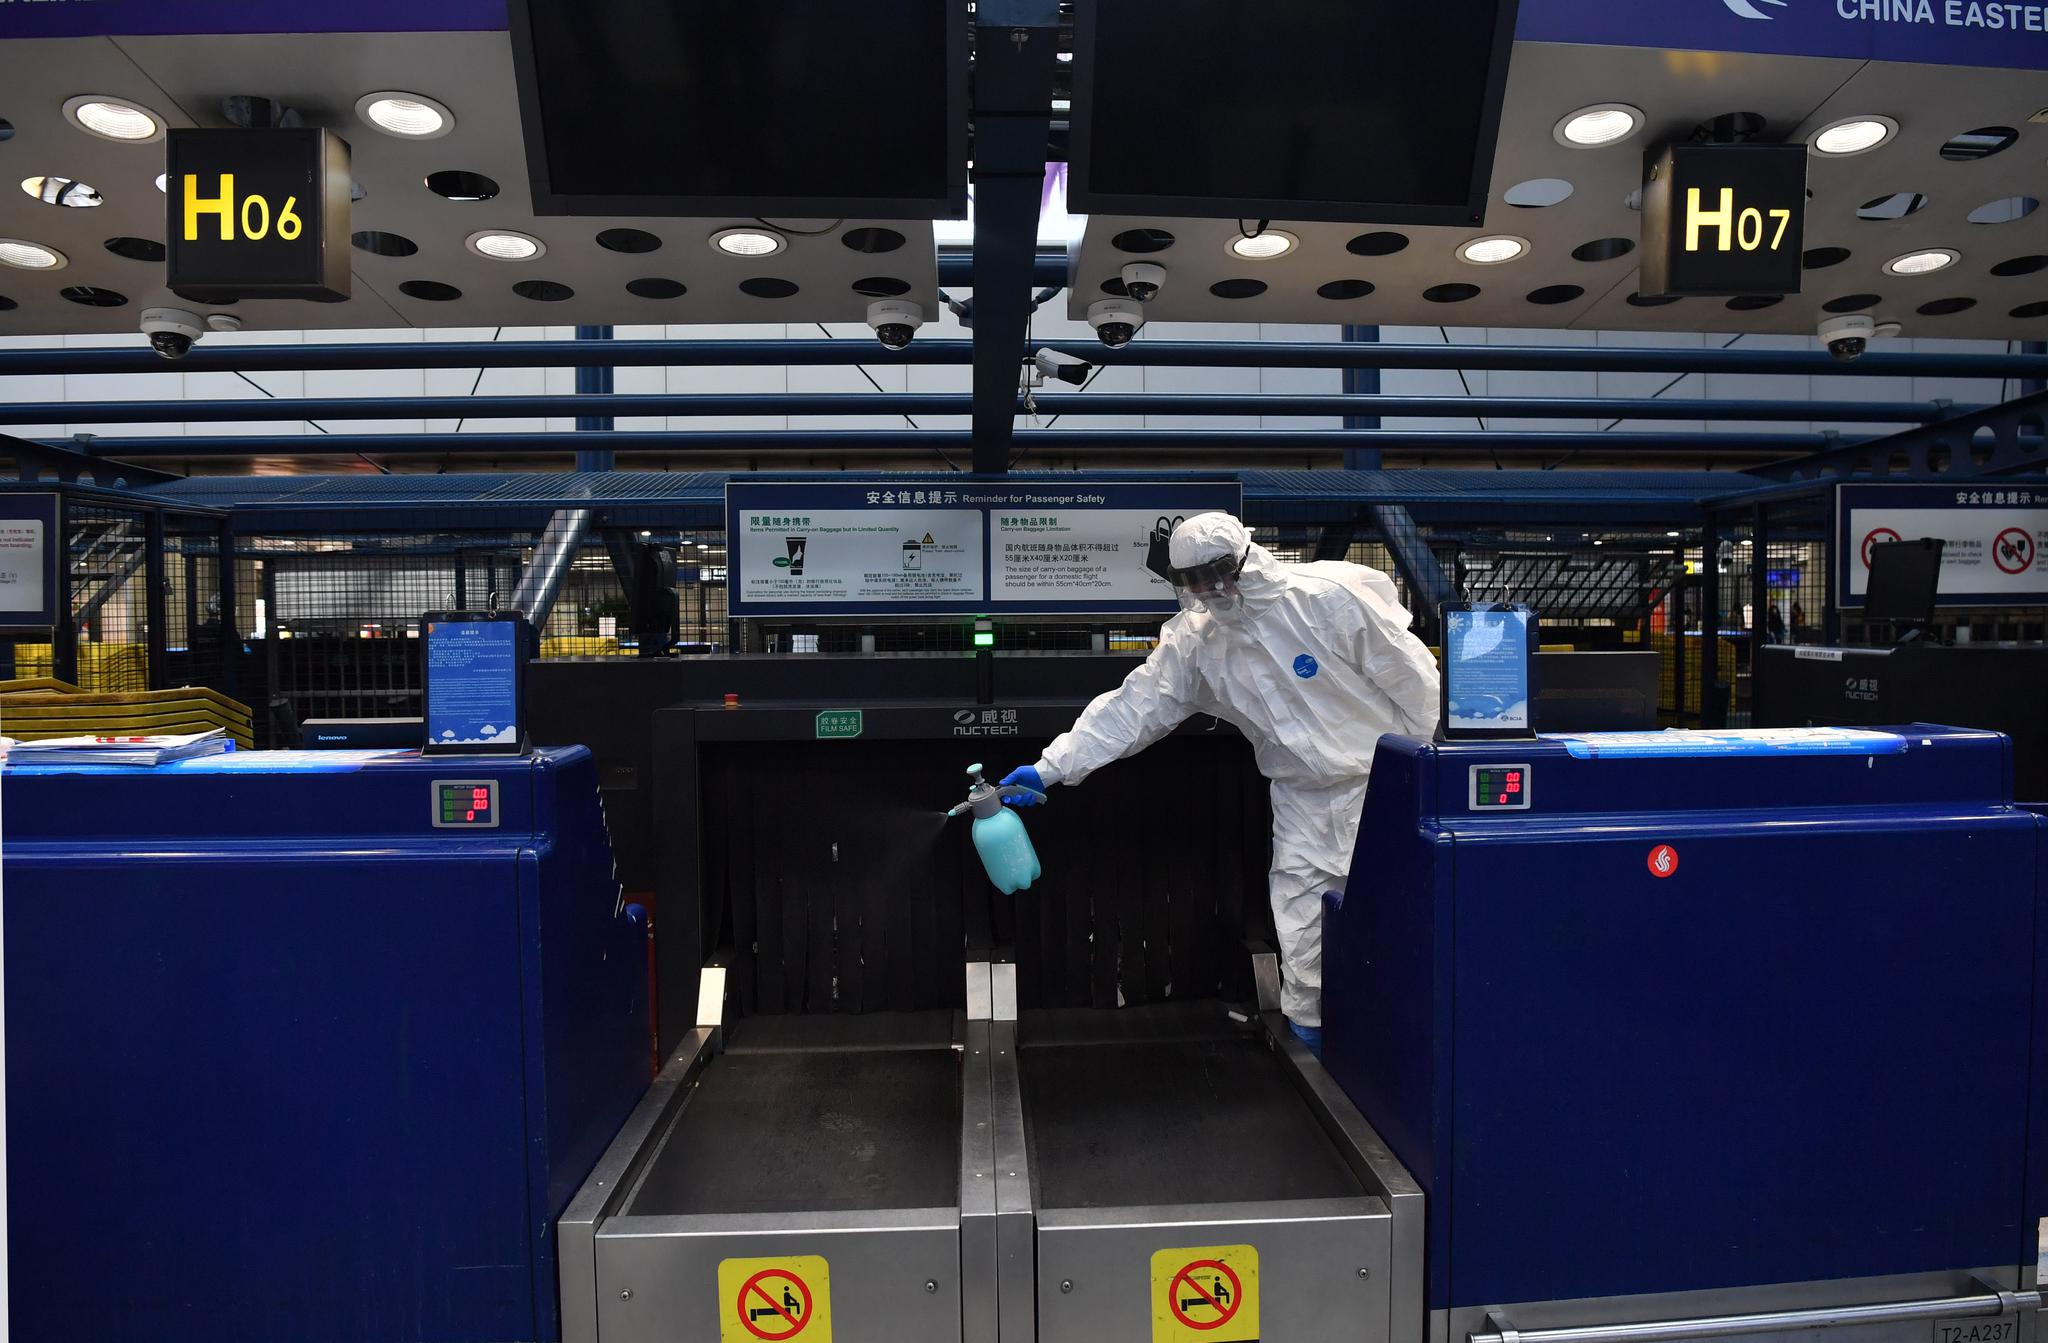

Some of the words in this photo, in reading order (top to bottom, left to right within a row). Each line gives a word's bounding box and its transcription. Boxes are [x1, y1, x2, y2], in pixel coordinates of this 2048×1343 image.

[1837, 0, 1935, 24] CHINA
[1945, 1, 2048, 32] EASTE
[184, 173, 302, 240] H06
[1686, 188, 1790, 251] H07
[867, 491, 957, 504] 安全信息提示
[962, 494, 1007, 503] Reminder
[1010, 494, 1022, 503] for
[1025, 494, 1073, 504] Passenger
[1076, 494, 1105, 504] Safety
[1956, 491, 2031, 504] 安全信息提示
[2034, 495, 2048, 503] Re
[750, 516, 811, 526] 限量随身携带
[1000, 517, 1057, 526] 随身物品限制
[1005, 543, 1119, 552] 国内航班随身物品体积不得超过
[982, 710, 1017, 724] 威视
[954, 726, 1018, 735] NUCTECH
[1499, 793, 1508, 804] 0
[466, 810, 475, 821] 0
[1941, 1323, 2013, 1343] T2-A237
